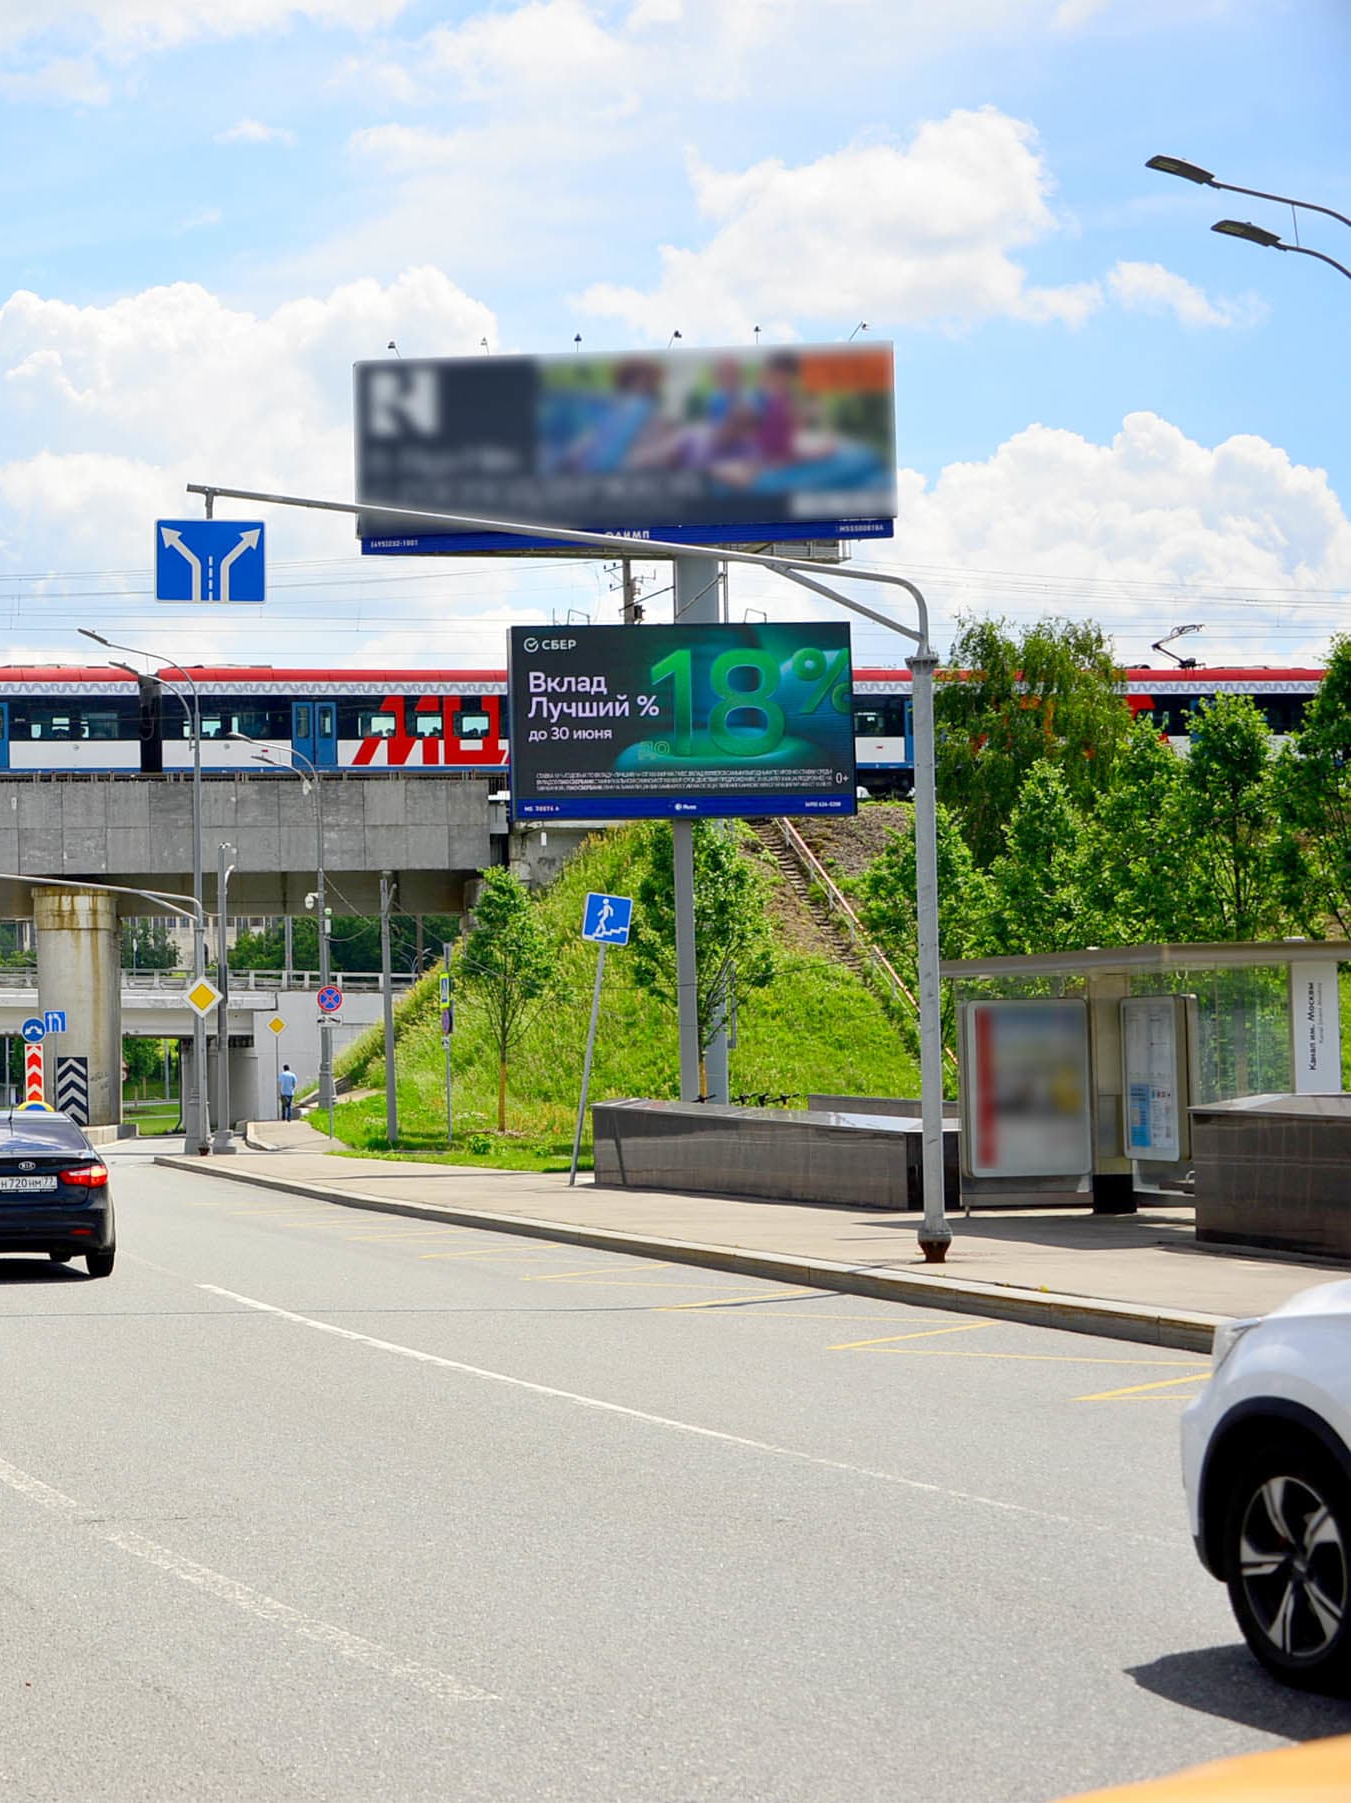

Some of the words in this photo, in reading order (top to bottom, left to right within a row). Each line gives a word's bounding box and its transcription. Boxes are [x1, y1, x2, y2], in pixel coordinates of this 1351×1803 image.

[541, 639, 577, 650] СБЕР
[528, 671, 608, 695] Вклад
[528, 694, 630, 723] Лучший
[637, 695, 660, 717] %
[652, 647, 850, 756] 18%
[352, 695, 509, 765] МЦ
[528, 730, 548, 742] до
[551, 726, 570, 740] 30
[573, 729, 612, 740] июня
[835, 772, 849, 784] 0+
[1307, 982, 1315, 1021] Москвы
[1308, 1042, 1317, 1071] Канал
